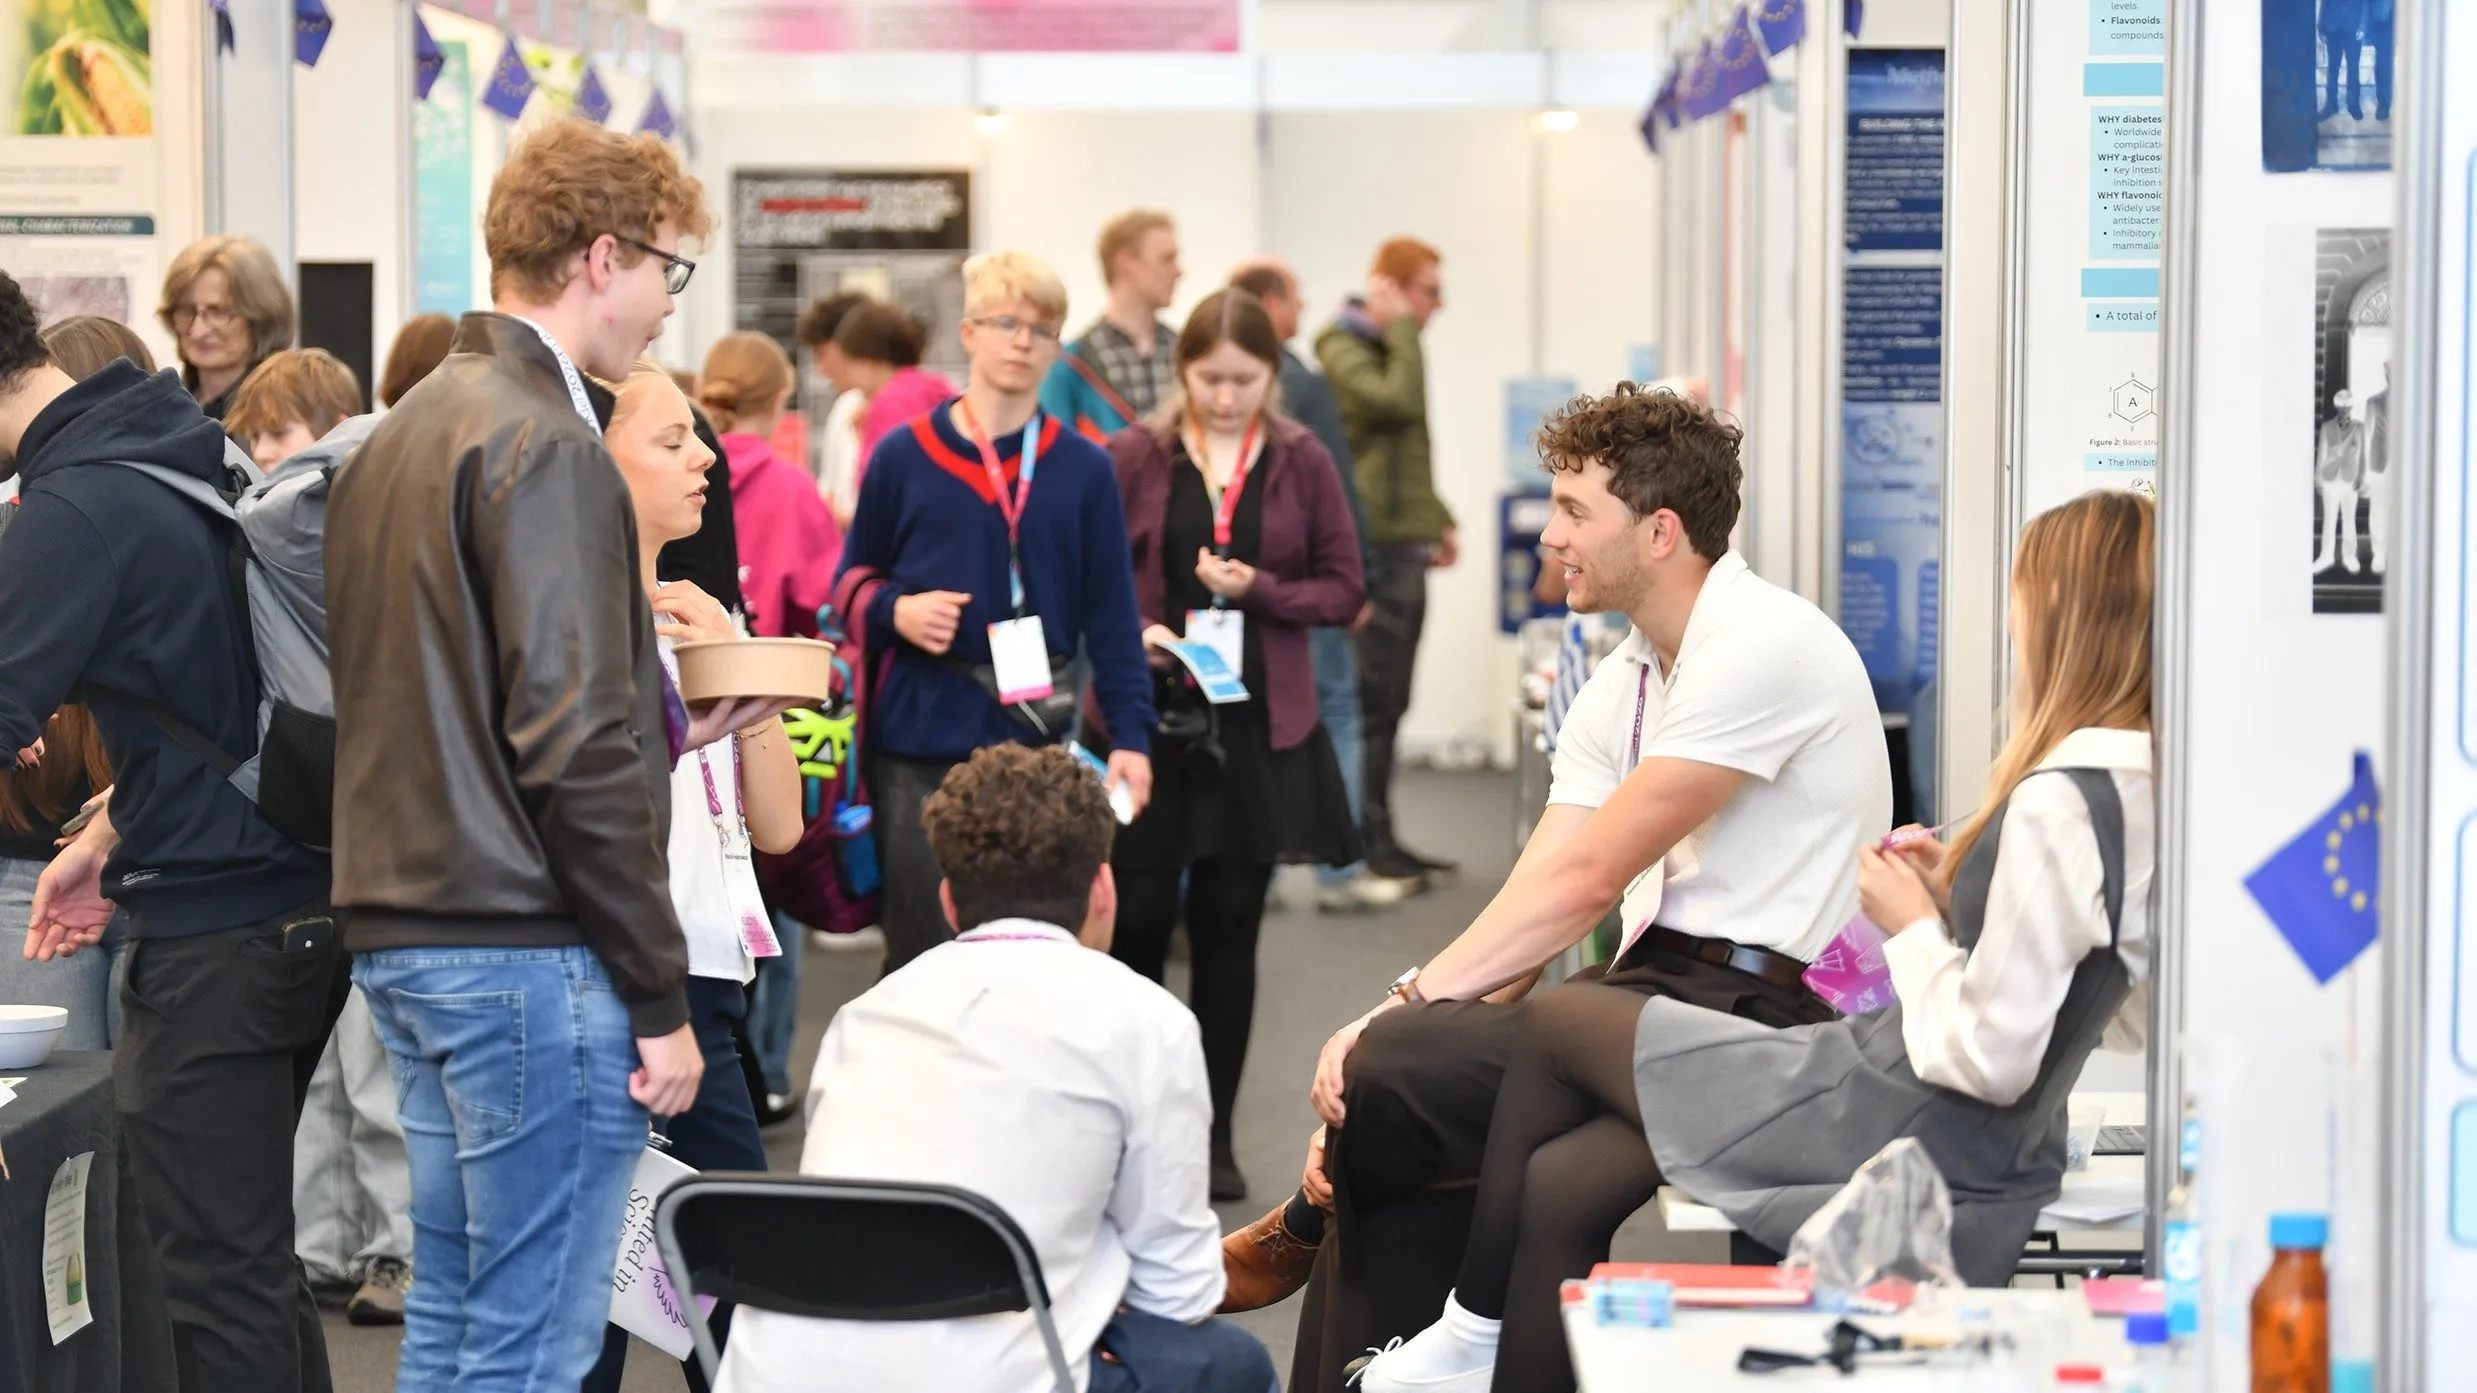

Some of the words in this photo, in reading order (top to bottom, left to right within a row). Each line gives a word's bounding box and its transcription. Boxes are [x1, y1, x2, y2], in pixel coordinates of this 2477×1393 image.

[2114, 128, 2162, 136] Worldwide
[2098, 153, 2120, 161] WHY
[2113, 166, 2130, 176] Key
[2113, 178, 2156, 187] inhibition
[2113, 204, 2142, 214] Widely
[2112, 229, 2157, 239] Inhibitory
[2106, 311, 2115, 321] A
[2117, 311, 2143, 321] total
[2145, 310, 2158, 321] of
[2128, 397, 2138, 407] A
[2089, 439, 2113, 447] Figure
[2108, 458, 2125, 467] The
[613, 1267, 637, 1294] in
